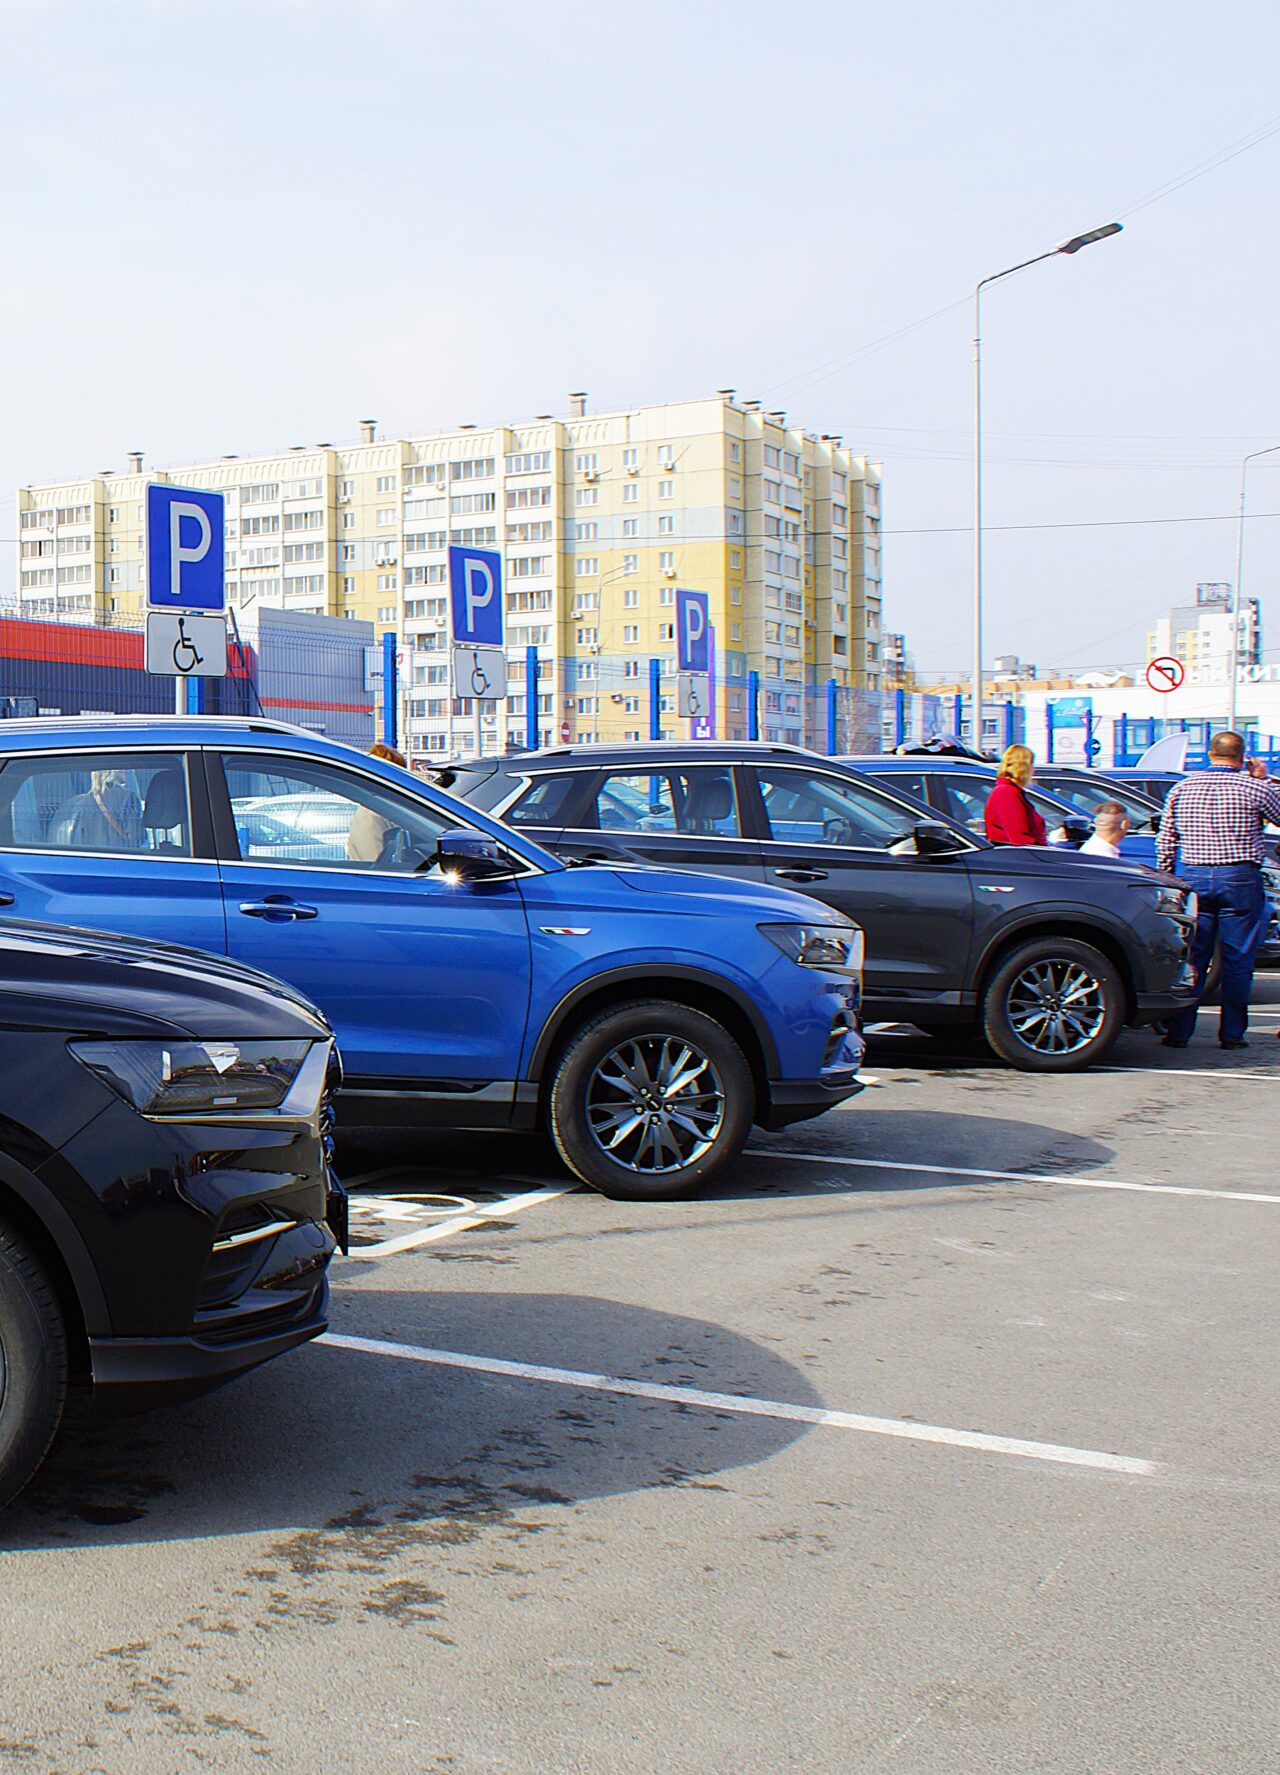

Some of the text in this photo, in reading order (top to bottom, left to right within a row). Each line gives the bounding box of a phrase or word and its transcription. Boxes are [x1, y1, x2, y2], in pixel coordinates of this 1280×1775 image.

[169, 501, 212, 594] P
[464, 558, 493, 632] P
[685, 599, 704, 662] P
